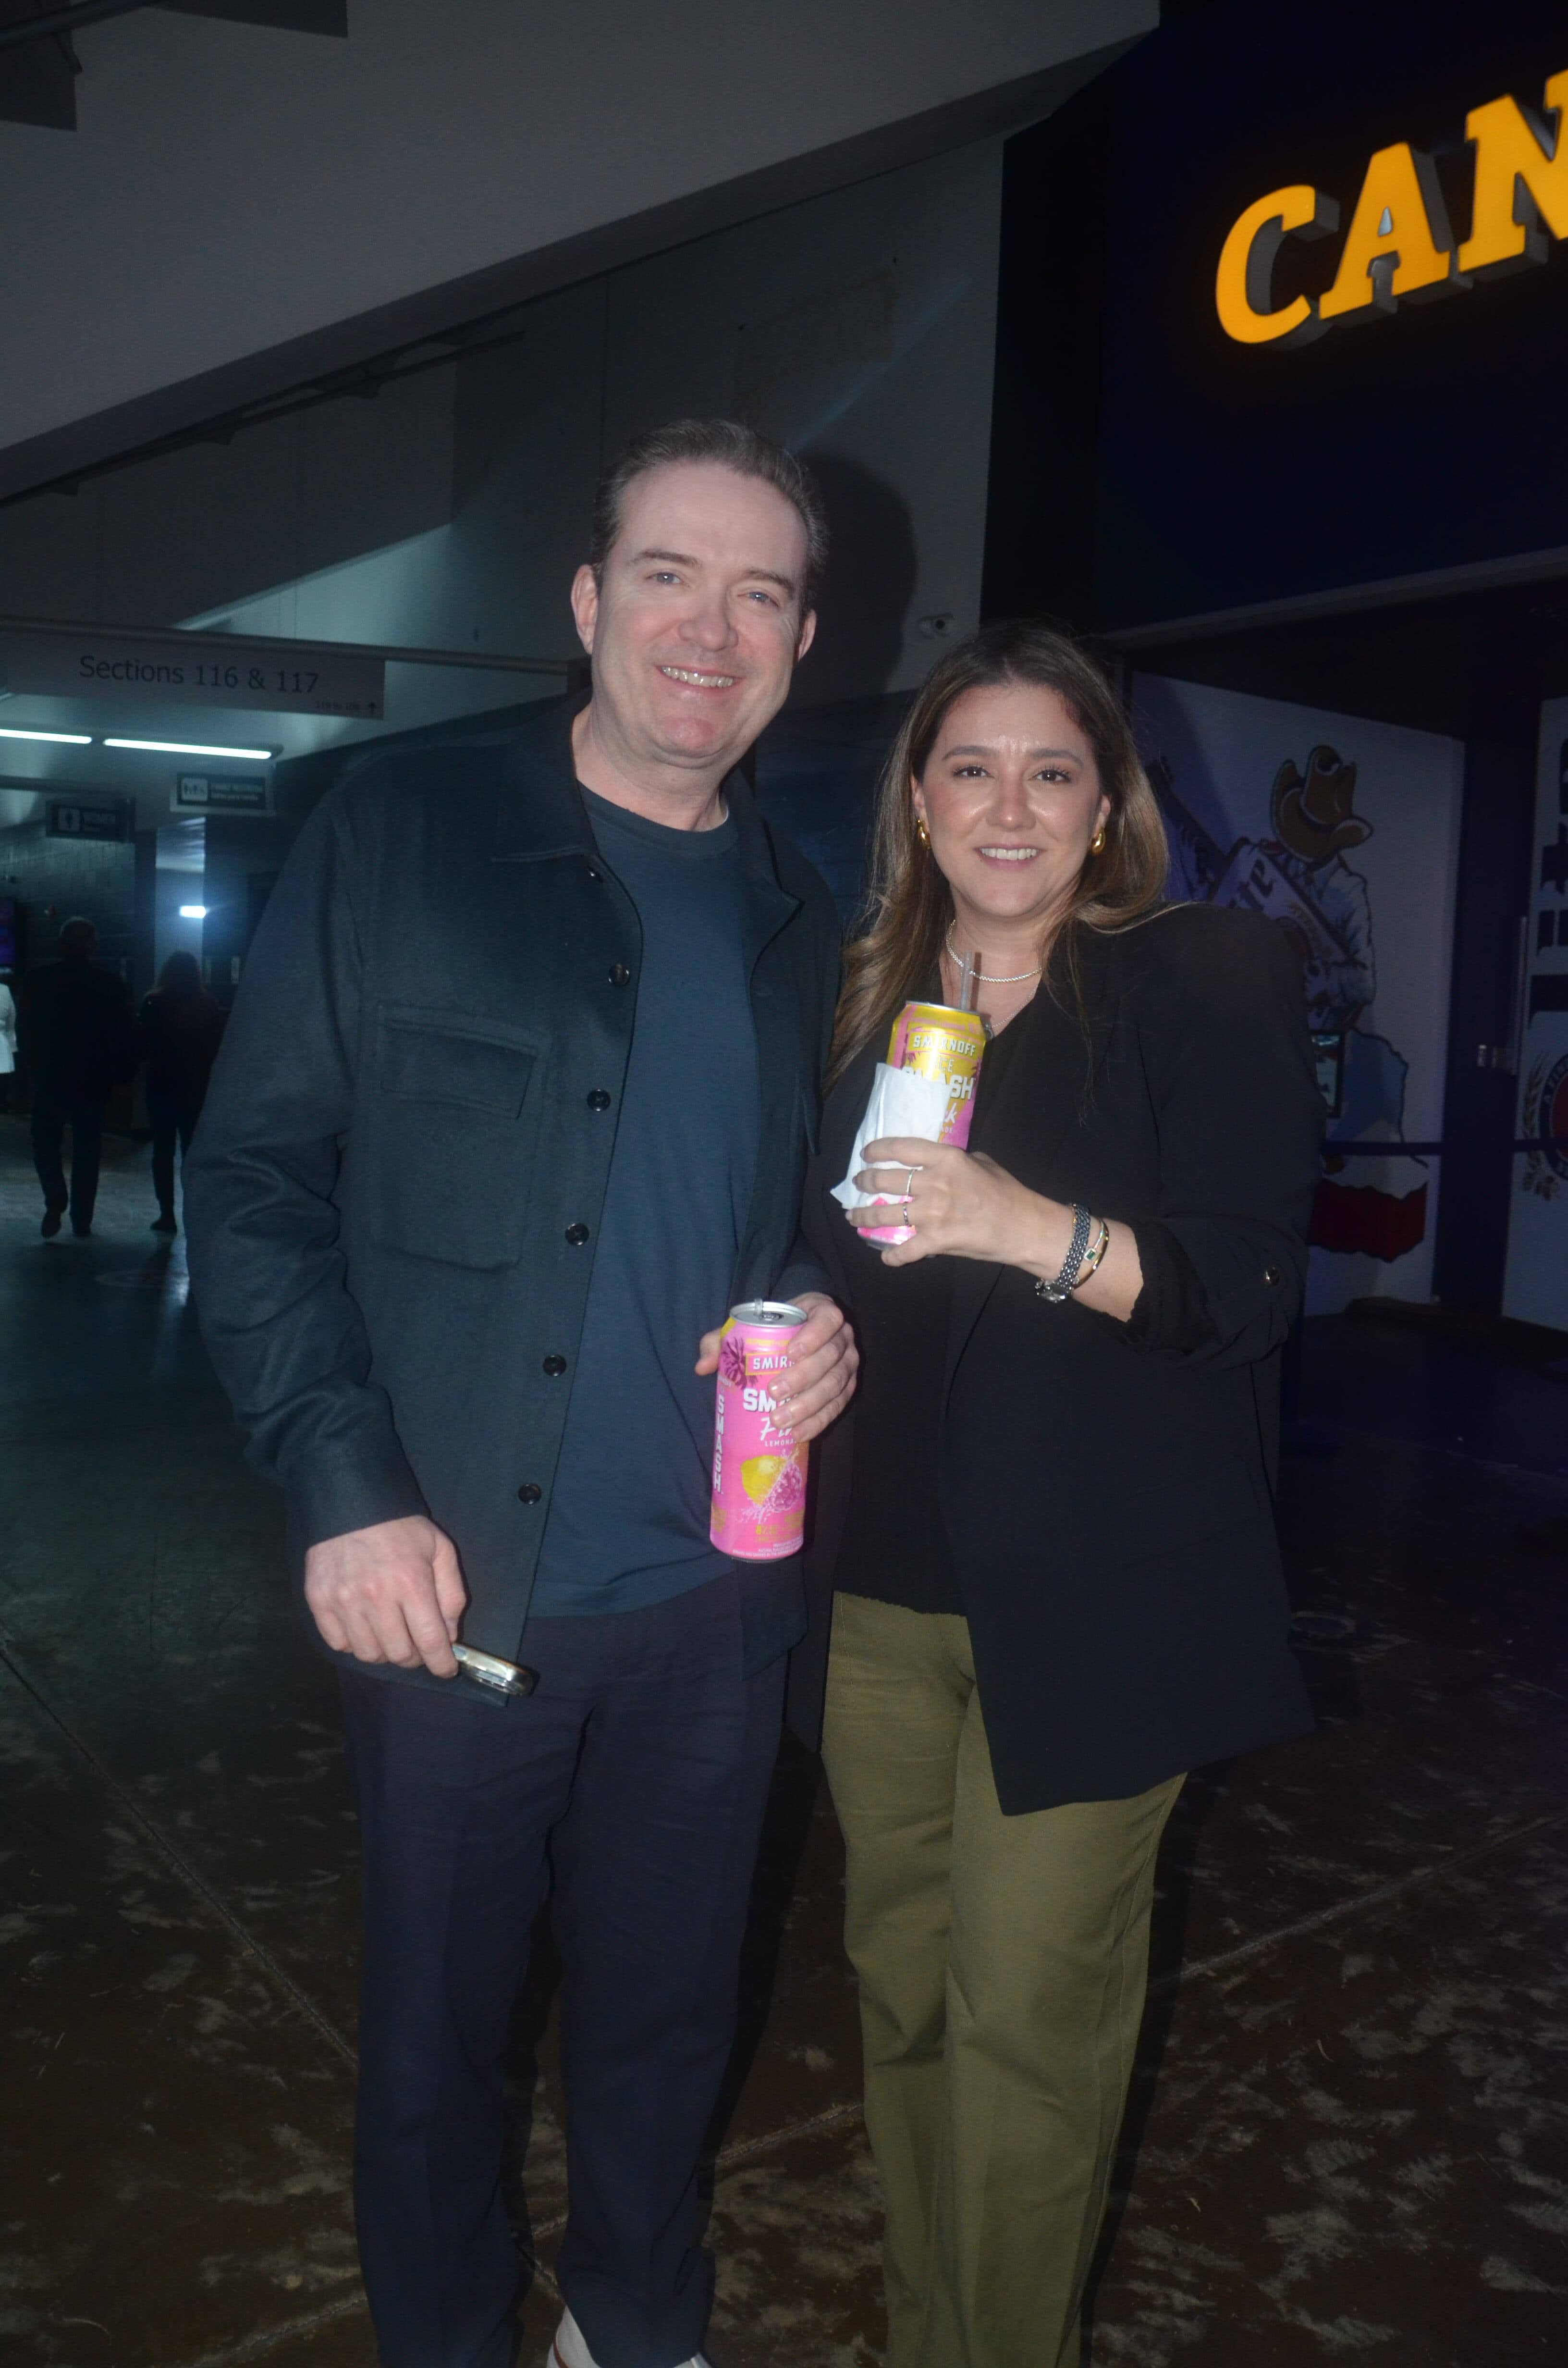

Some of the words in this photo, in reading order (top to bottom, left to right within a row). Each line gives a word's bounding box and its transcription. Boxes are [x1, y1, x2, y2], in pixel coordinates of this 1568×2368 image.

[1216, 68, 1568, 343] CAN
[79, 655, 184, 684] Sections
[195, 665, 238, 688] 116
[248, 668, 266, 690] &
[277, 670, 319, 693] 117
[913, 1036, 976, 1057] SMRNOFF
[753, 1355, 792, 1370] SMIR
[714, 1394, 724, 1493] SMASH
[764, 1439, 796, 1447] LEMONA
